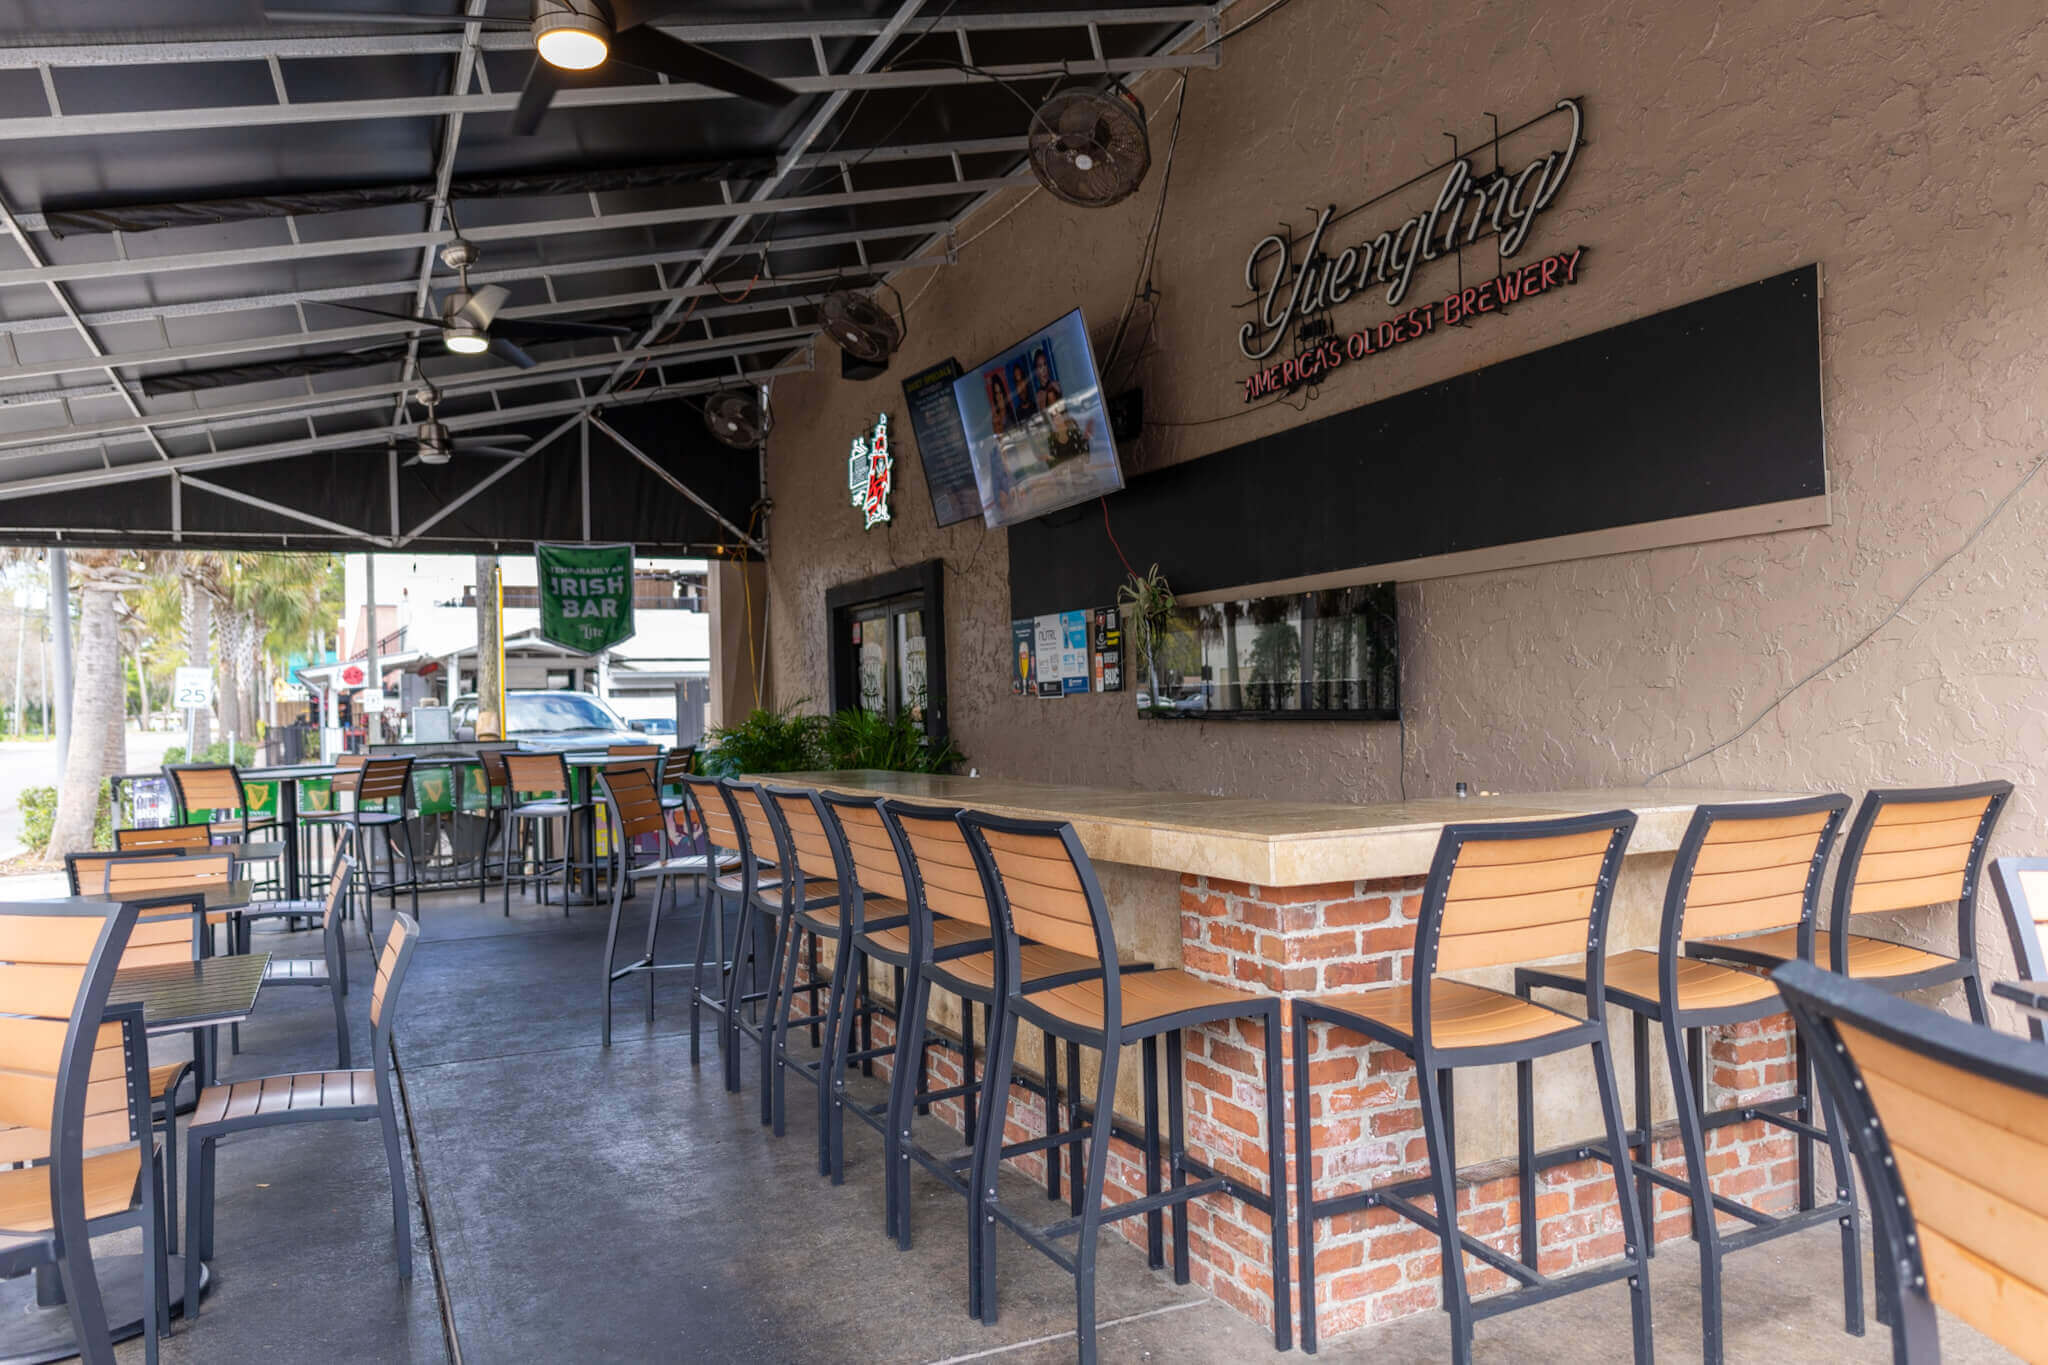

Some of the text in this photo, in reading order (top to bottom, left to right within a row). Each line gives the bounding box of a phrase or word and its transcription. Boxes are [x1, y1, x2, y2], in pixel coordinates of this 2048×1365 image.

[1239, 99, 1584, 360] Yuengling
[1245, 248, 1585, 402] AMERICA'S OLDEST BREWERY
[551, 575, 624, 597] IRISH
[562, 598, 617, 618] BAR
[180, 688, 206, 703] 25
